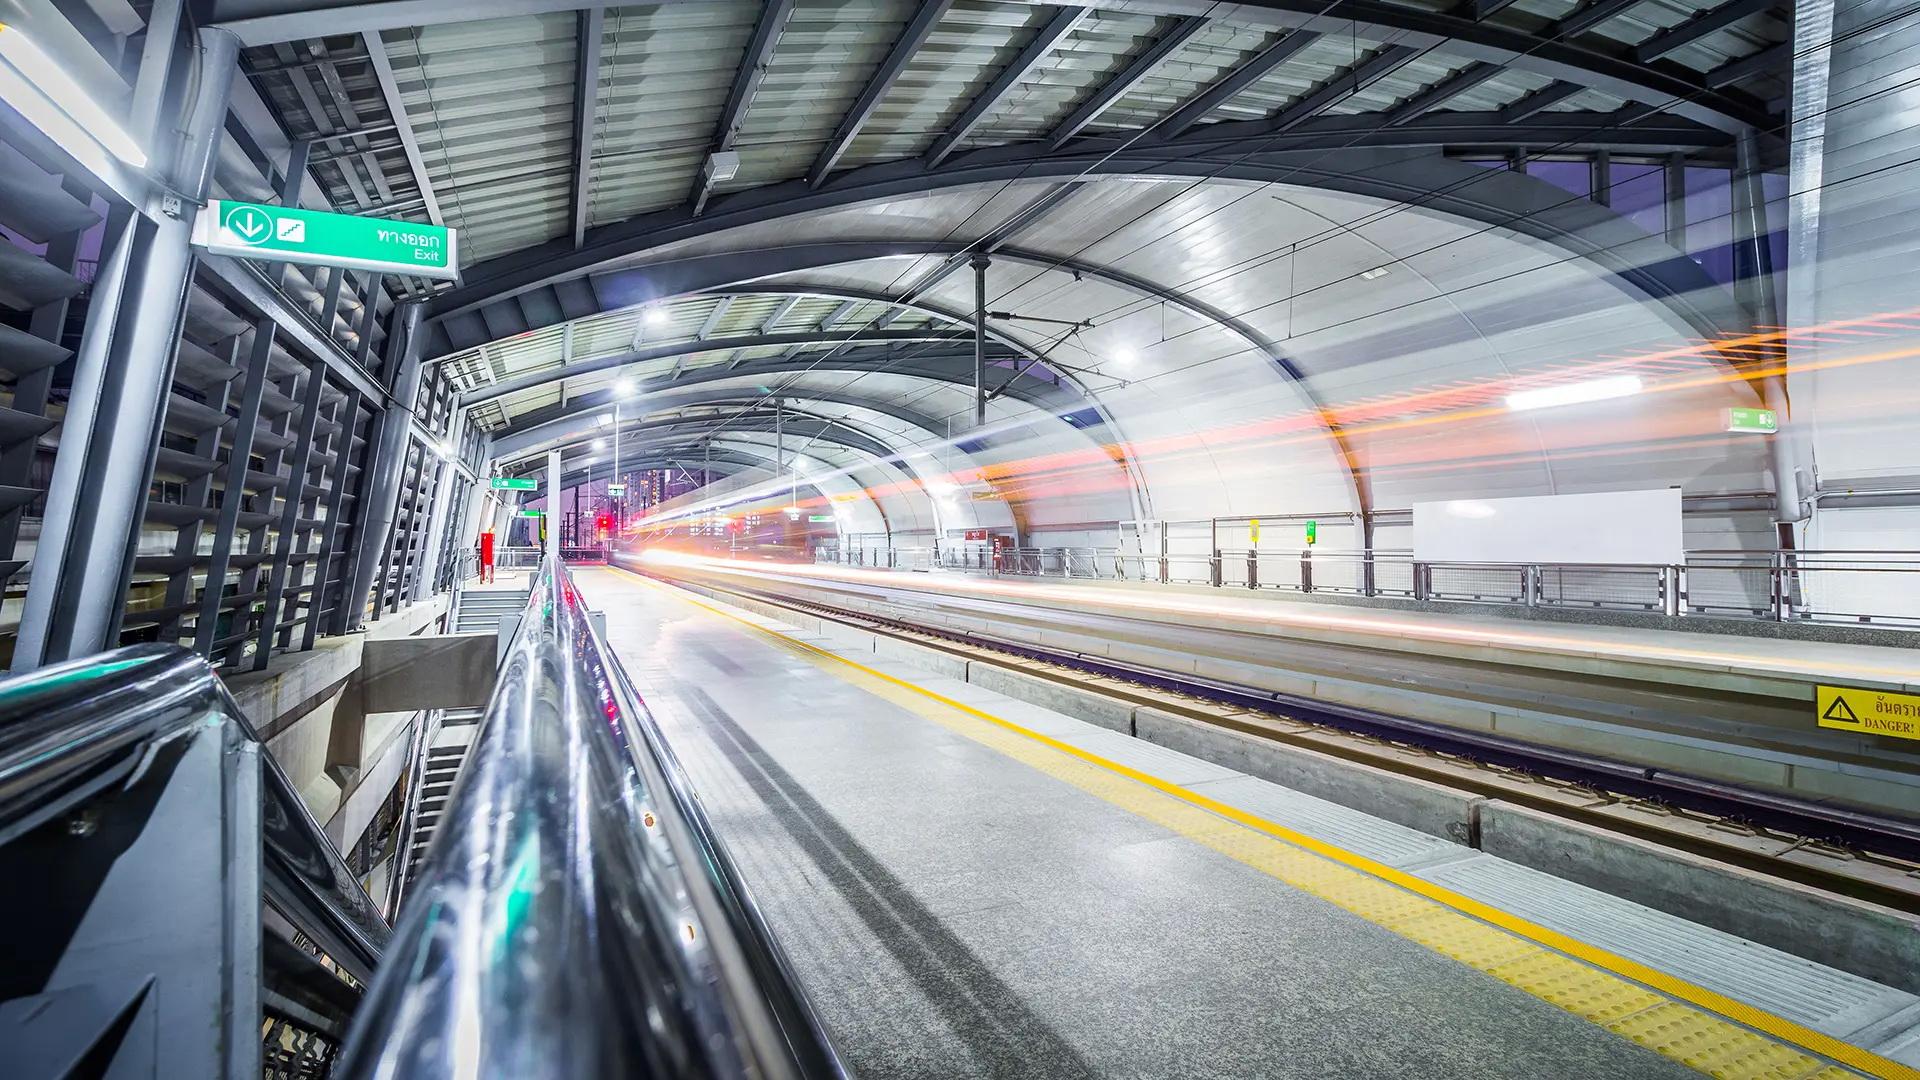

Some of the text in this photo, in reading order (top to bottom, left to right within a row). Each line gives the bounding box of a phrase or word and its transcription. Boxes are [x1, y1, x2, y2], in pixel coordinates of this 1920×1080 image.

[377, 229, 440, 249] ทางออก
[414, 248, 440, 261] Exit
[1864, 717, 1914, 733] DANGER!
